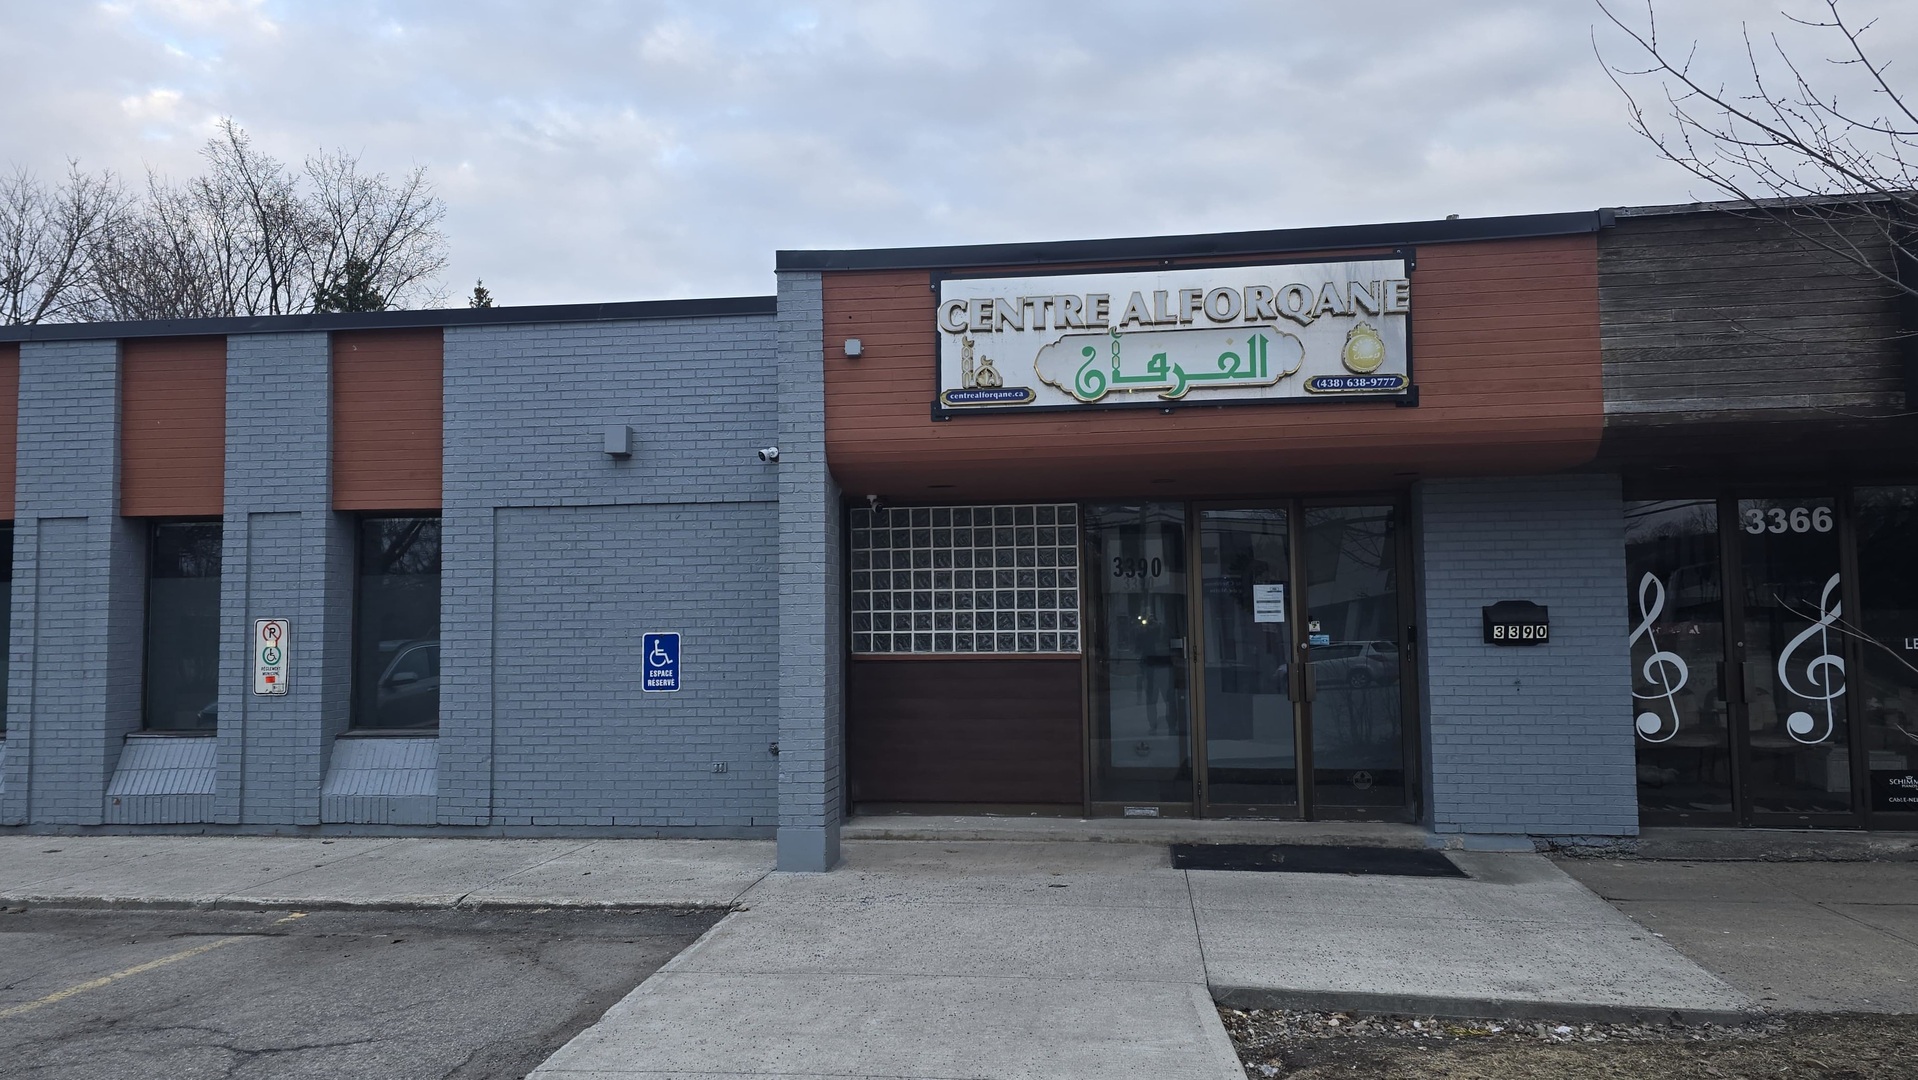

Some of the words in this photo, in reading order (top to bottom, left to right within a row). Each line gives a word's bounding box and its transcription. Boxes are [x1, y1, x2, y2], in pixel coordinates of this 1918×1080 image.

[937, 293, 1110, 334] CENTRE
[1119, 279, 1410, 328] ALFORQANE
[1316, 378, 1344, 388] (438)
[1346, 377, 1396, 388] 638-9777
[950, 390, 1024, 400] centrealforqane.ca
[1745, 506, 1833, 535] 3366
[1113, 556, 1162, 578] 3390
[1494, 626, 1547, 638] 3390
